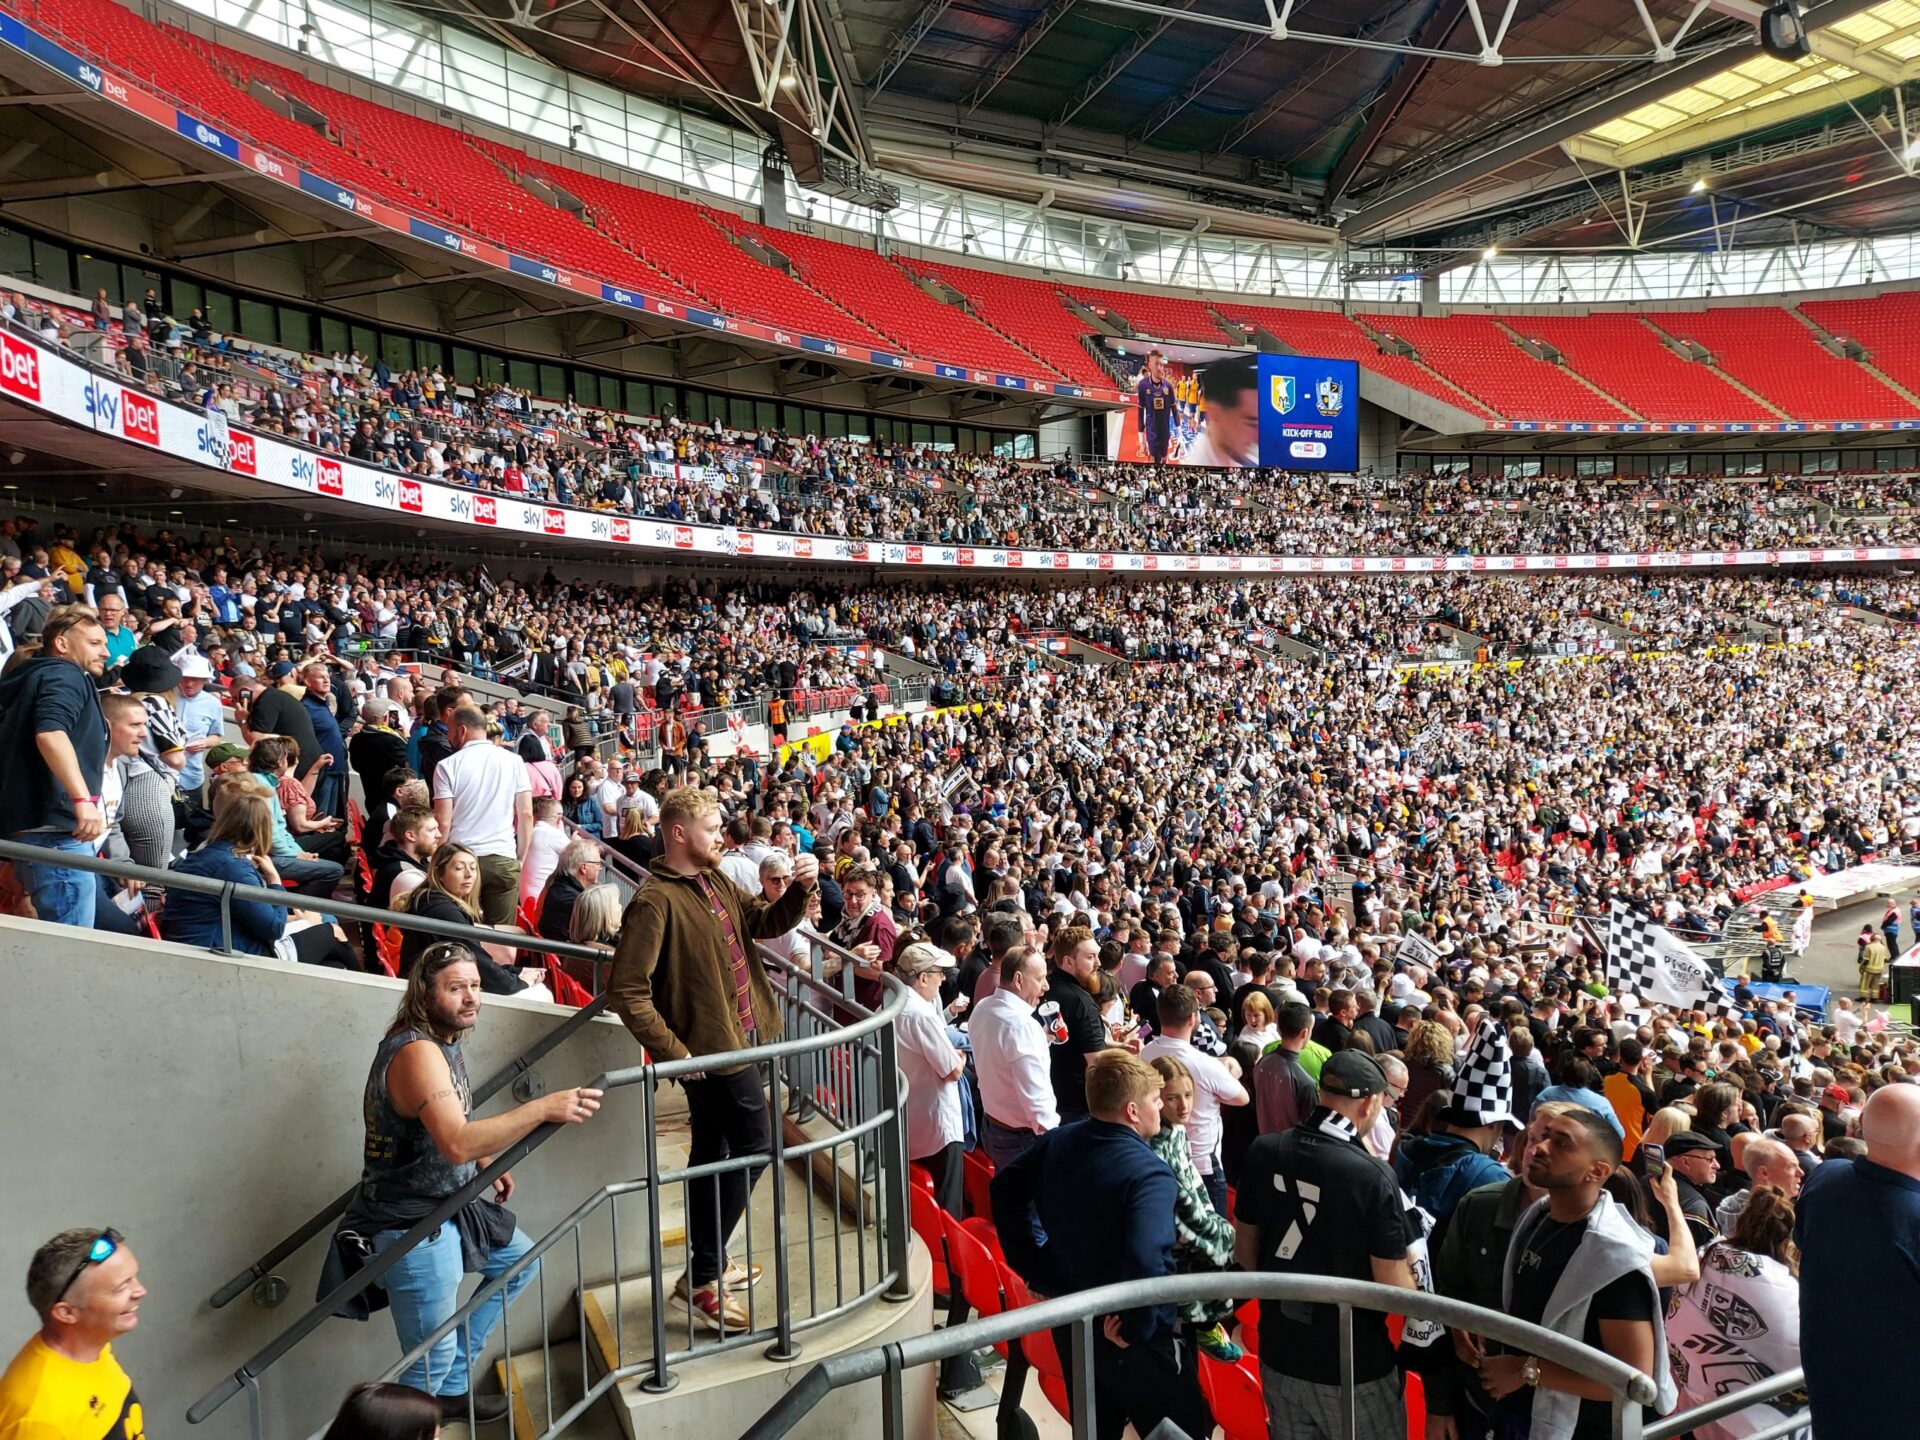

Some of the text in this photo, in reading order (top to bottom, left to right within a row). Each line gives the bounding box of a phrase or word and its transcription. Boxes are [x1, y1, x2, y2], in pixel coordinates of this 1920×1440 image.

[80, 66, 128, 102] sky bet
[209, 132, 221, 147] EFL
[268, 162, 284, 177] EFL
[338, 192, 372, 215] sky bet
[445, 234, 476, 254] sky bet
[542, 268, 572, 286] sky bet
[713, 318, 738, 330] sky bet
[824, 344, 848, 356] sky bet
[1, 336, 38, 389] bet
[84, 382, 156, 434] sky bet
[1282, 428, 1332, 438] KICK-OFF 16:00
[292, 454, 340, 489] sky bet
[375, 476, 422, 506] sky bet
[450, 494, 496, 518] sky bet
[524, 508, 564, 530] sky bet
[592, 518, 630, 538] sky bet
[656, 526, 692, 544] sky bet
[776, 538, 810, 554] sky bet
[890, 546, 921, 560] sky bet
[942, 550, 972, 563] sky bet
[993, 552, 1021, 565] sky bet
[1040, 555, 1068, 566] sky bet
[1086, 556, 1112, 566] sky bet
[1130, 556, 1156, 568] sky bet
[1406, 1327, 1430, 1340] SEASO
